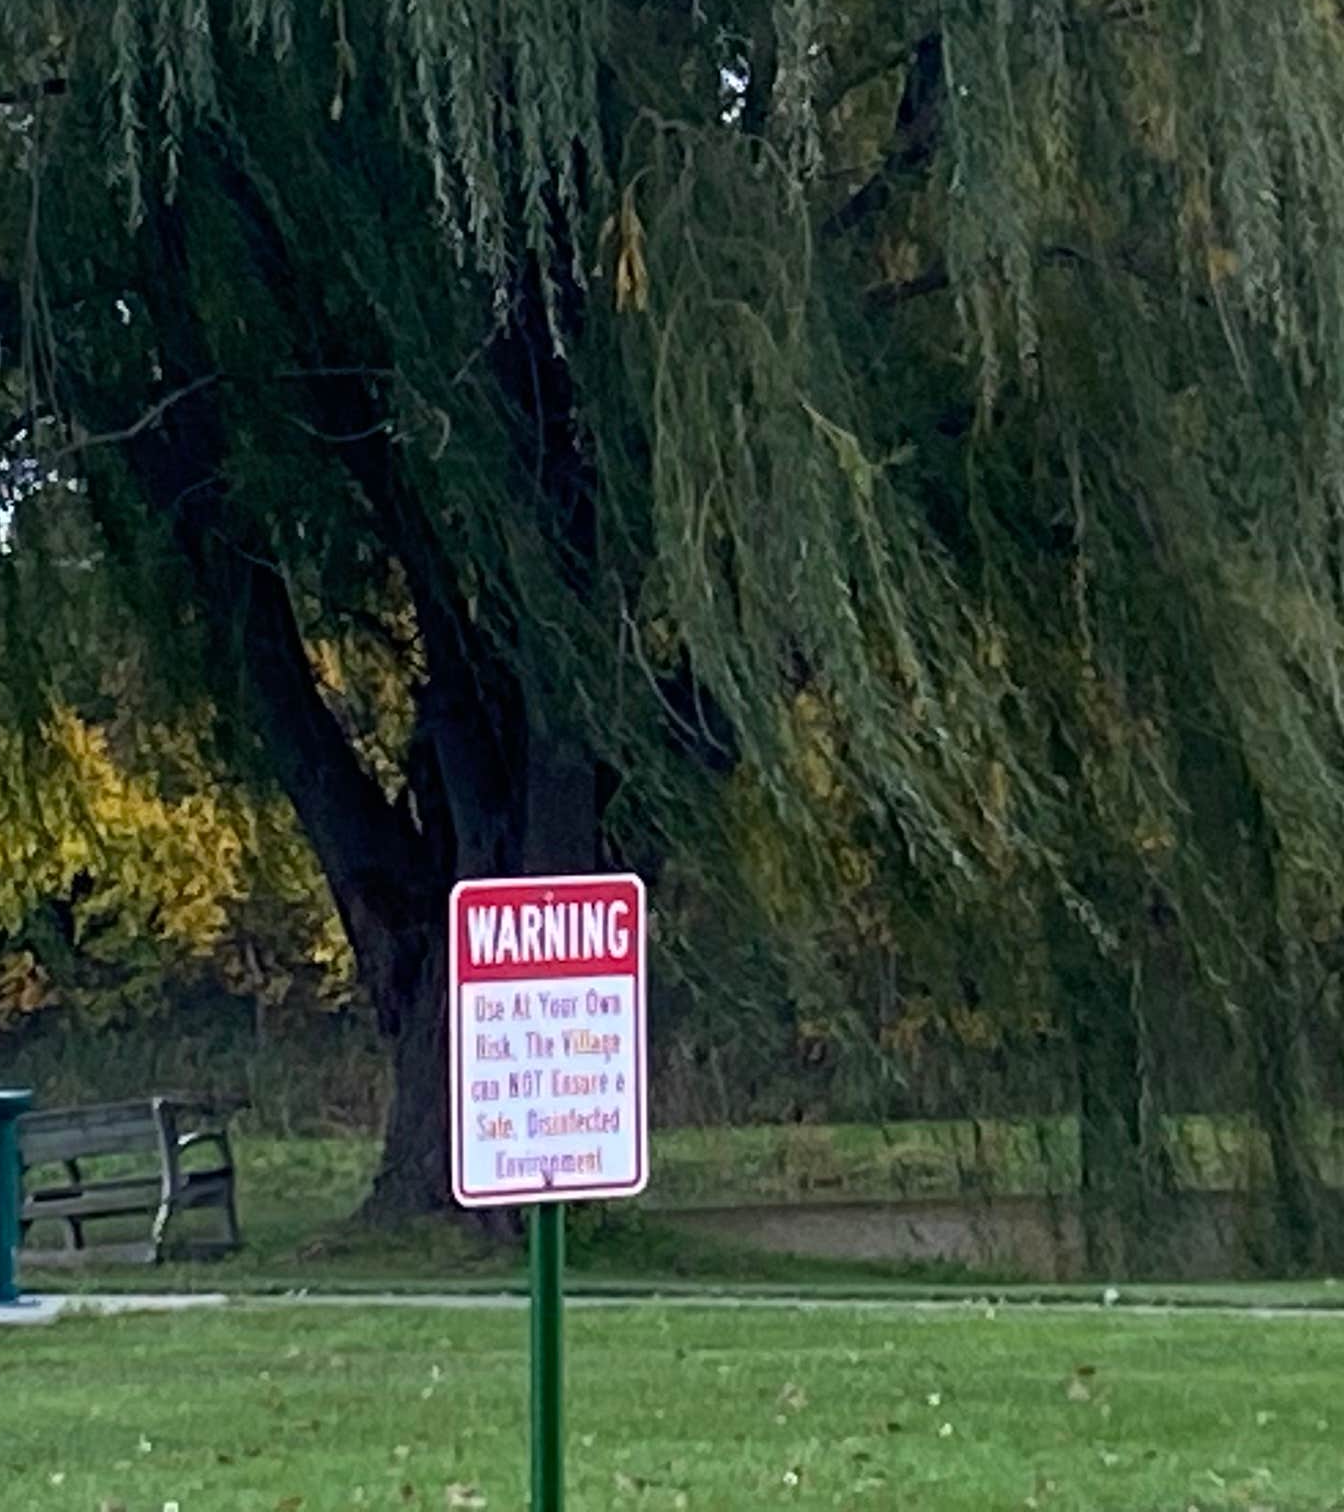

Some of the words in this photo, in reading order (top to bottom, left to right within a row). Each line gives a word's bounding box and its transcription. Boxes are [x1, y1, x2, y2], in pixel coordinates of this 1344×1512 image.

[467, 899, 629, 966] WARNING
[475, 995, 504, 1023] Use
[512, 991, 531, 1020] At
[538, 990, 578, 1018] Your
[585, 988, 621, 1016] Own
[526, 1031, 554, 1058] The
[561, 1029, 621, 1064] Village
[471, 1079, 500, 1102] can
[509, 1069, 543, 1098] NOT
[551, 1069, 608, 1097] Ensure
[616, 1072, 625, 1093] a
[527, 1106, 620, 1138] Disinfected
[496, 1146, 602, 1179] Environment
